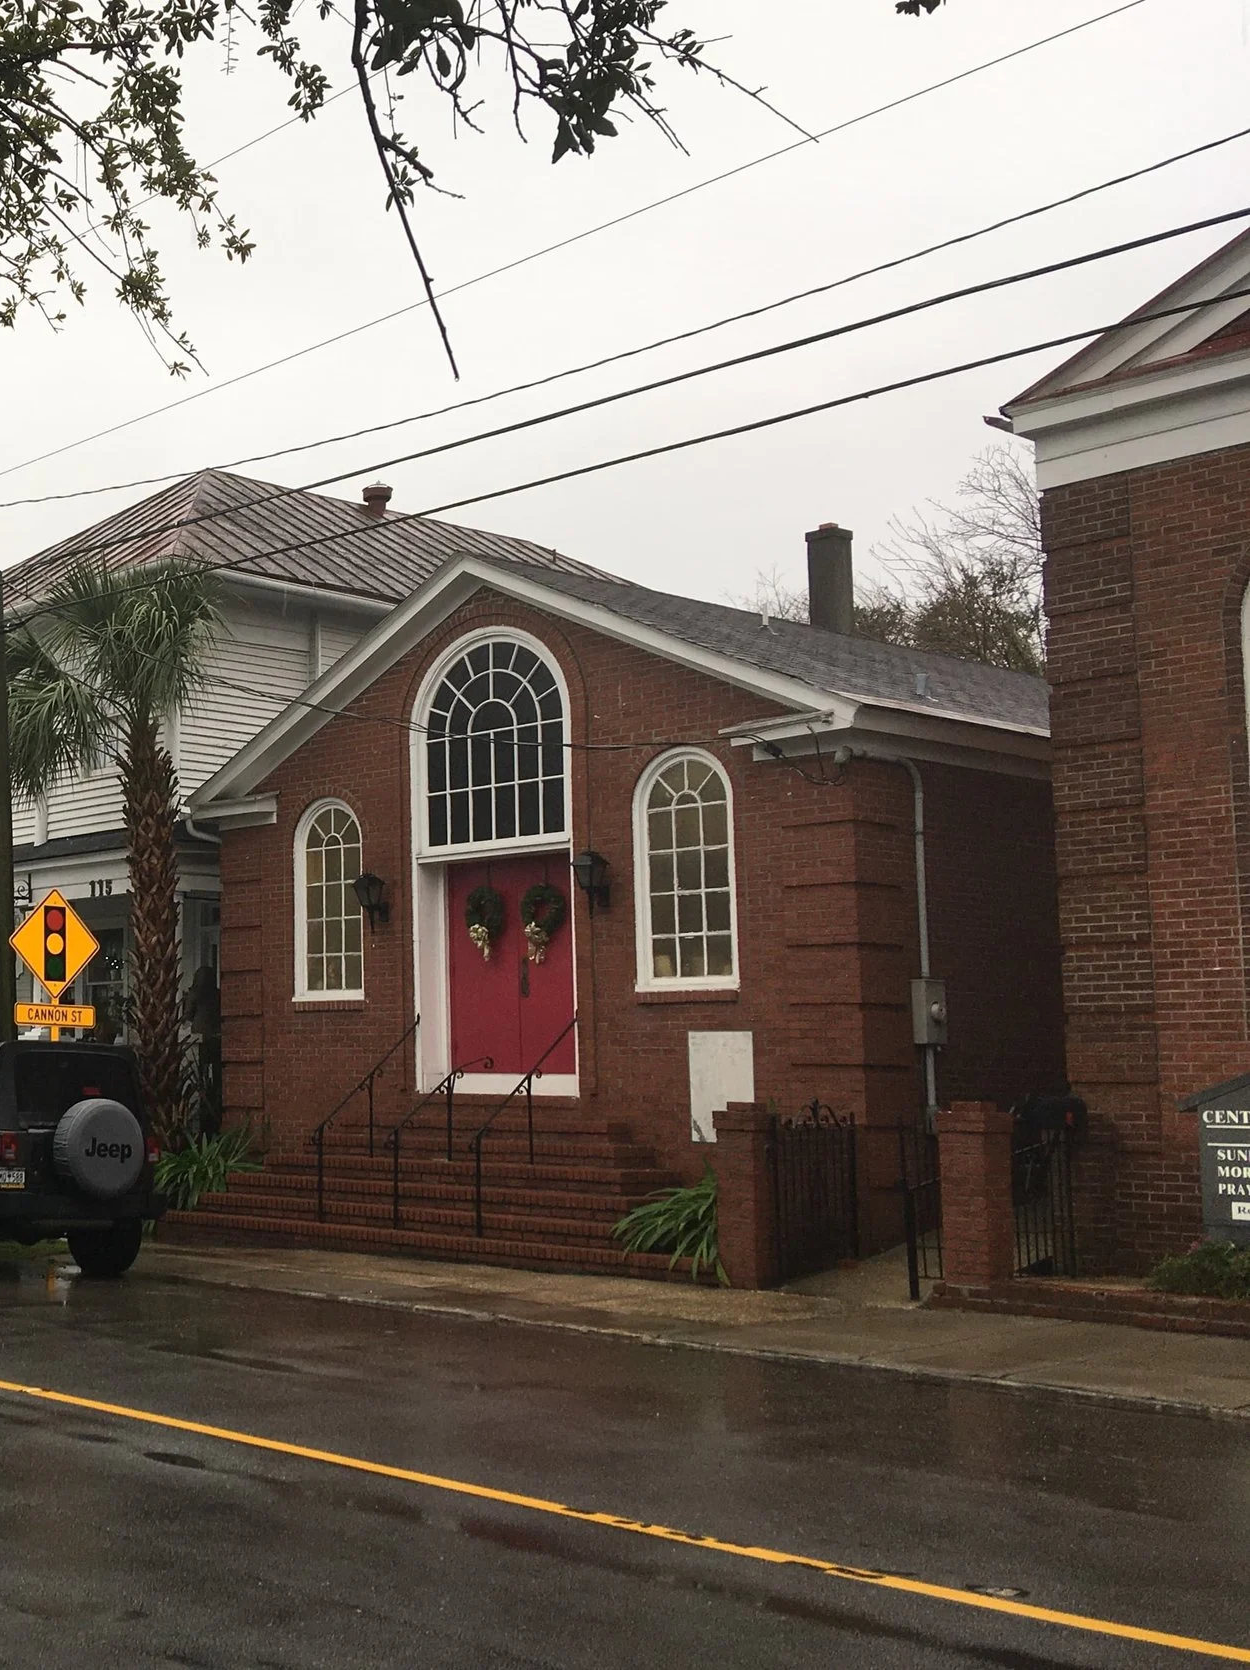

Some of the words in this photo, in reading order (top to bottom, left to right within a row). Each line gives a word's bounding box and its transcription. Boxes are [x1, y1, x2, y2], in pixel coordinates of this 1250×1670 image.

[89, 880, 113, 897] 115
[28, 1008, 68, 1022] CANNON
[71, 1009, 82, 1023] ST
[85, 1136, 132, 1163] Jeep
[1217, 1149, 1250, 1161] SUN
